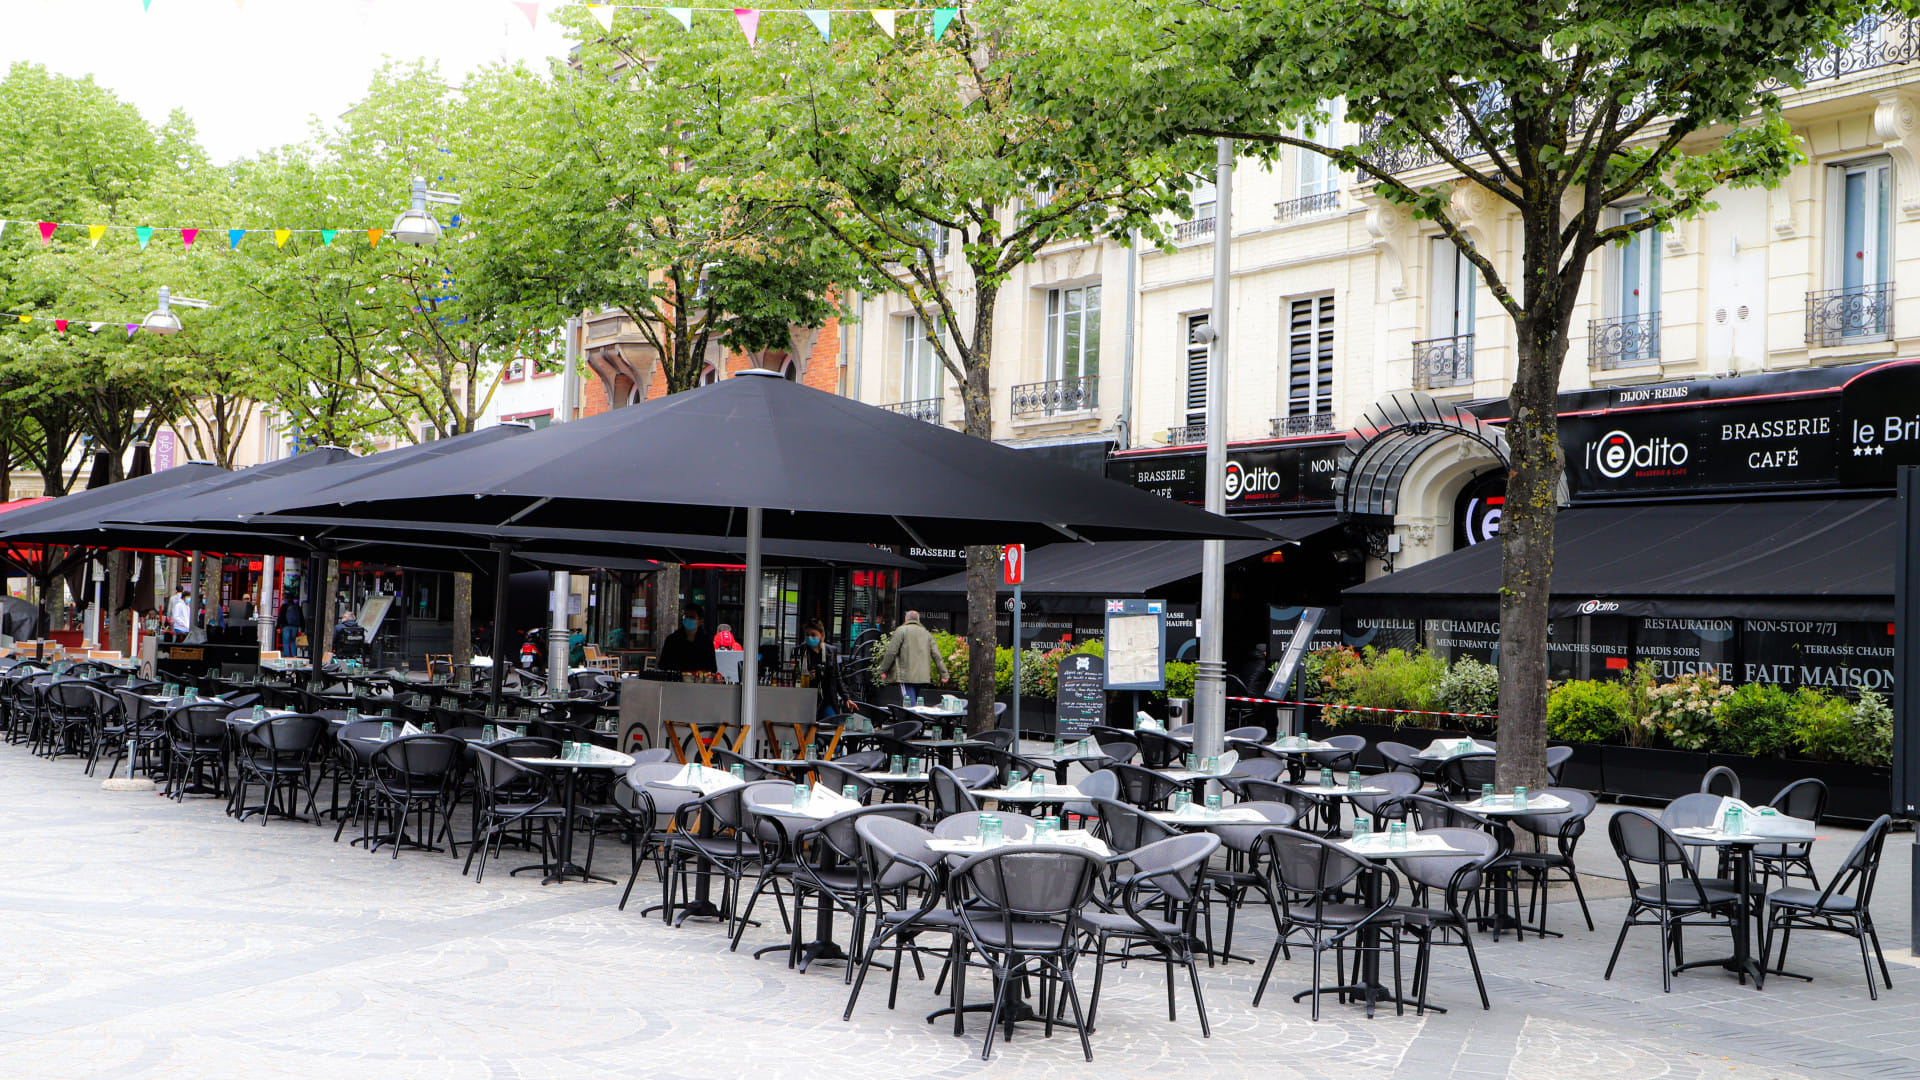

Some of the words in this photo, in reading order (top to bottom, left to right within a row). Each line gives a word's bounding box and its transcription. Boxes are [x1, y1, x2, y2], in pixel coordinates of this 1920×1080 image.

[1620, 387, 1688, 402] DIJON-REIMS
[1721, 417, 1830, 440] BRASSERIE
[1853, 419, 1875, 444] le
[1884, 414, 1920, 442] Bri
[1749, 447, 1799, 468] CAFÉ
[1311, 459, 1335, 472] NON
[1138, 469, 1186, 482] BRASSERIE
[910, 547, 957, 558] BRASSERIE
[1357, 618, 1416, 630] BOUTEILLE
[1425, 619, 1439, 632] DE
[1644, 618, 1733, 631] RESTAURATION
[1747, 620, 1814, 633] NON-STOP
[1815, 622, 1837, 637] 7/7J
[1436, 638, 1458, 648] MENU
[1459, 639, 1487, 649] ENFANT
[1591, 644, 1616, 654] SOIRS
[1617, 646, 1628, 655] ET
[1636, 646, 1672, 656] MARDIS
[1673, 647, 1700, 657] SOIRS
[1804, 644, 1854, 656] TERRASSE
[1744, 663, 1795, 684] FAIT
[1800, 665, 1894, 689] MAISON
